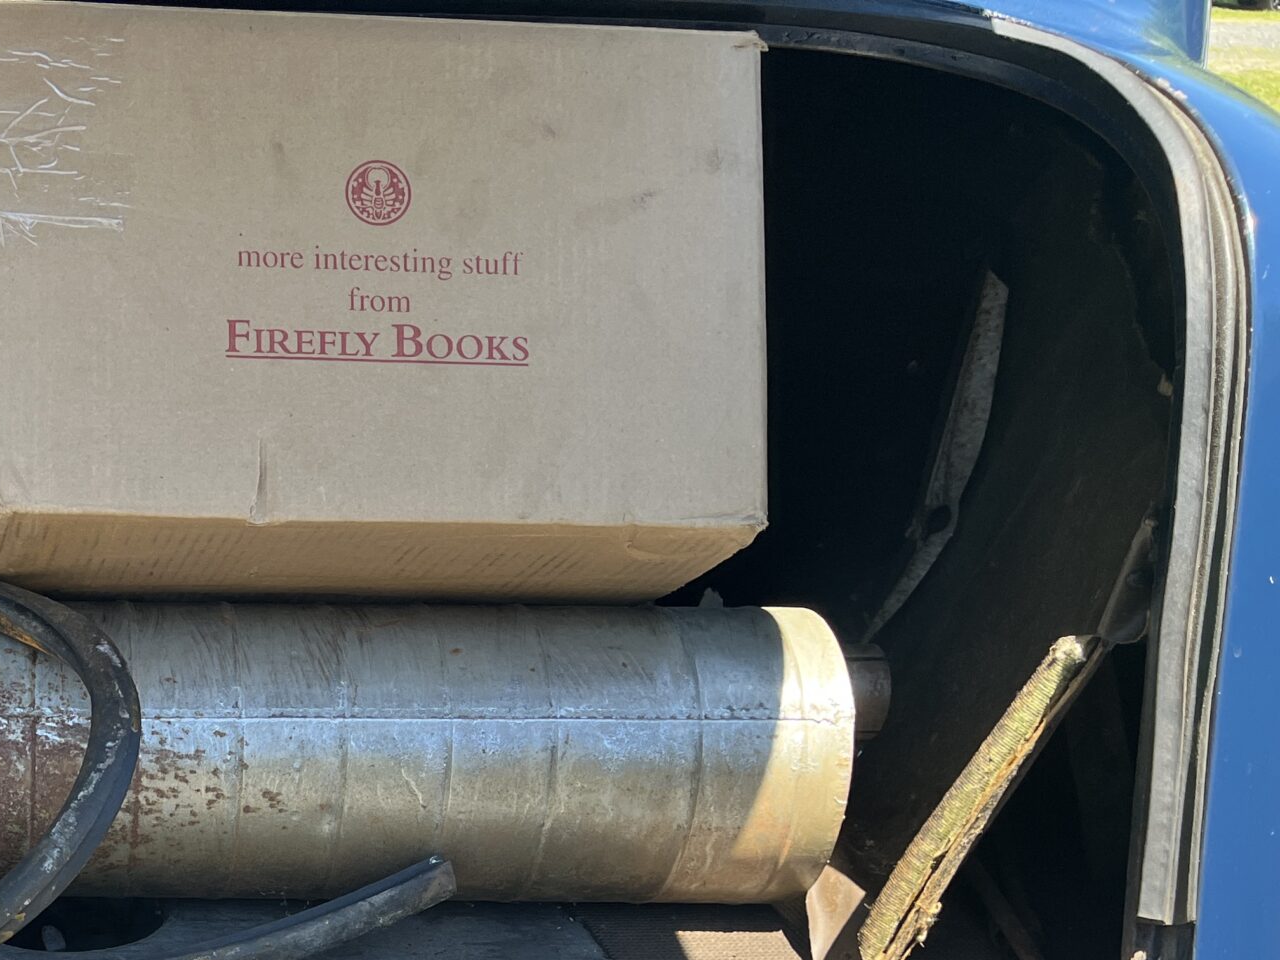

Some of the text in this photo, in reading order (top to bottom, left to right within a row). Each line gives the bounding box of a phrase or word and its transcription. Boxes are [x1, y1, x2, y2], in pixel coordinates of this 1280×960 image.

[237, 245, 523, 281] more interesting stuff
[348, 287, 411, 313] from
[225, 319, 529, 361] FIREFLY BOOKS
